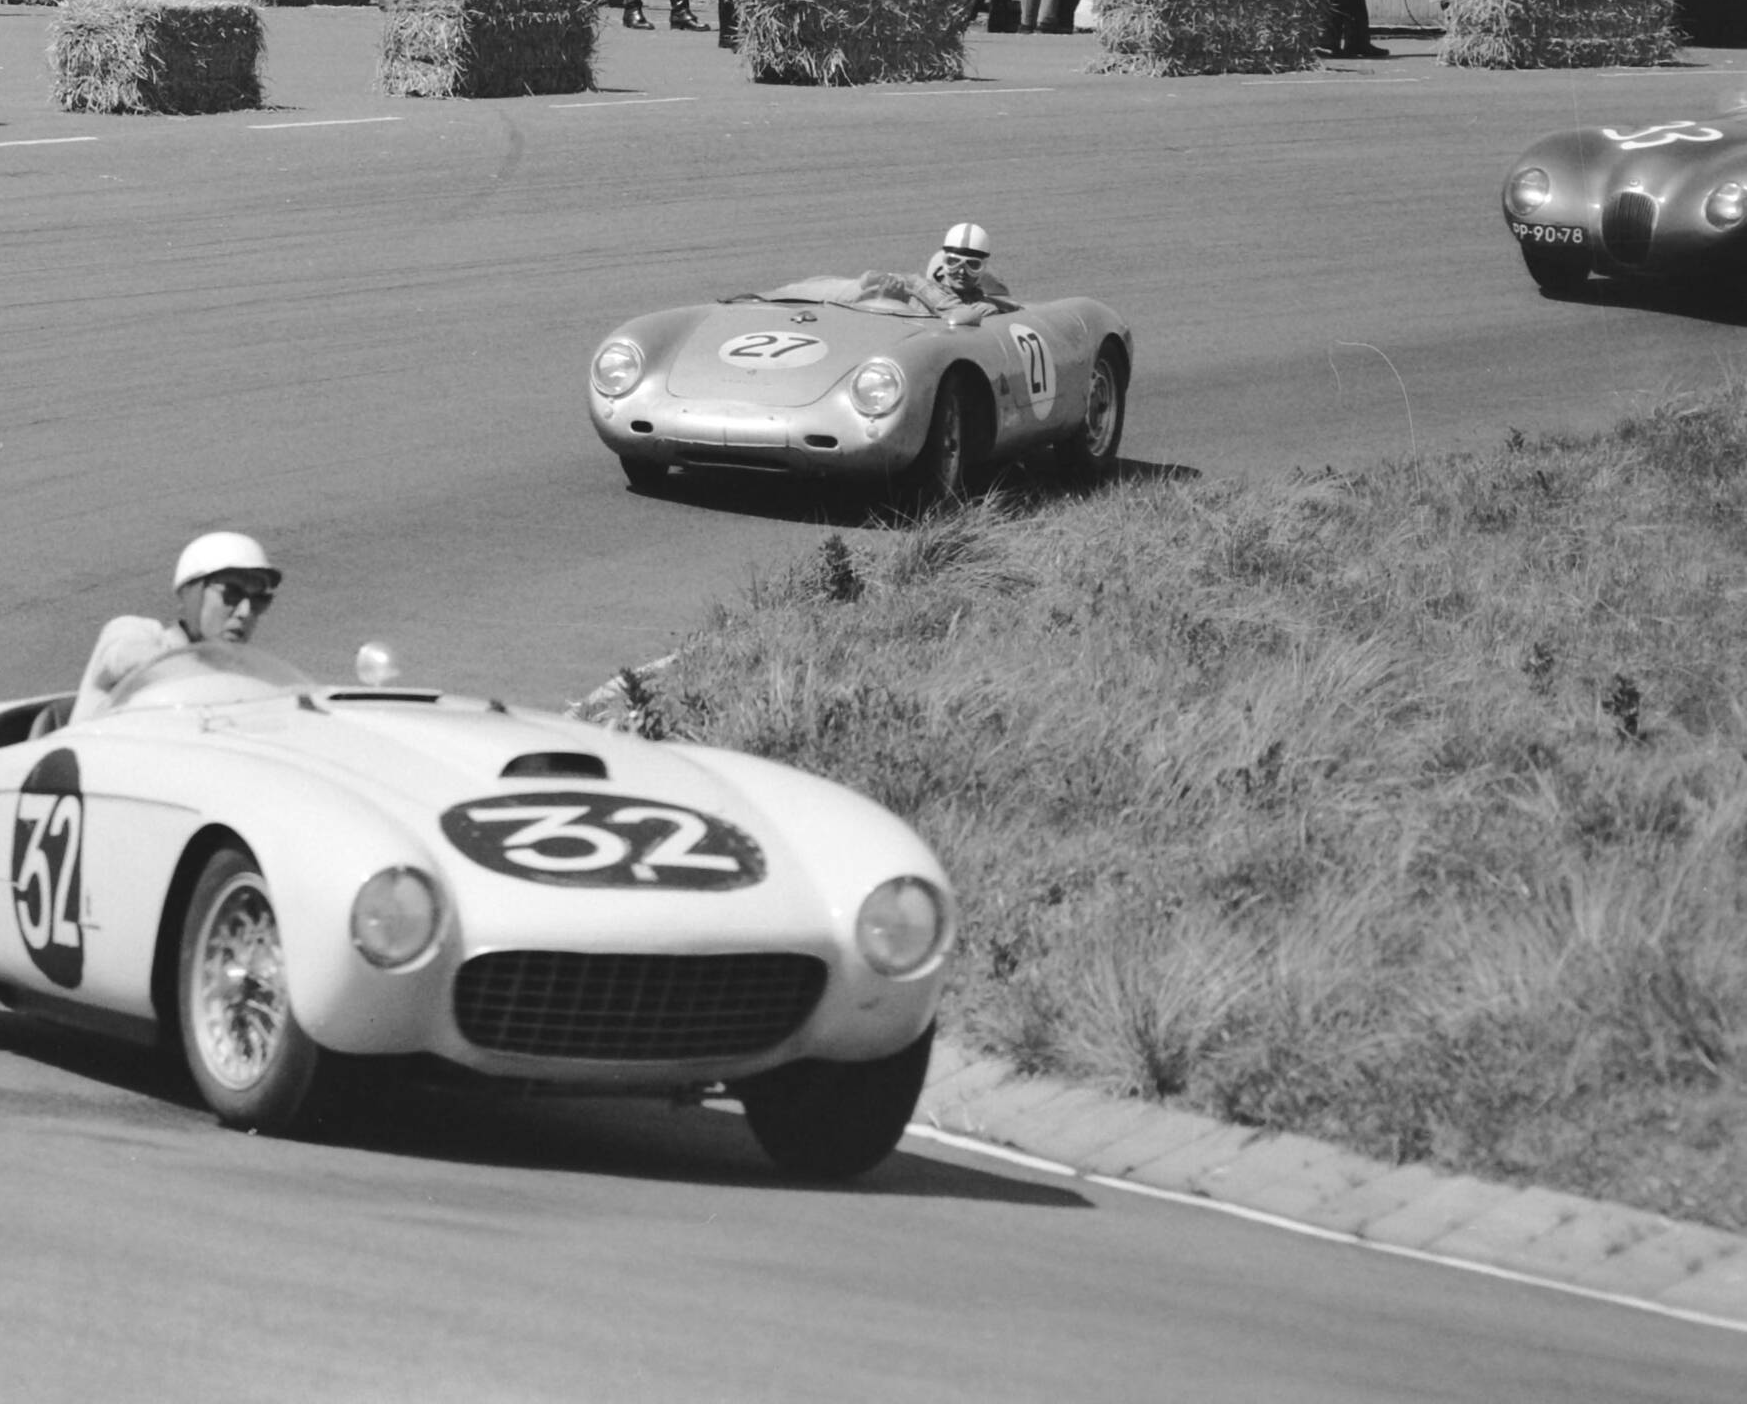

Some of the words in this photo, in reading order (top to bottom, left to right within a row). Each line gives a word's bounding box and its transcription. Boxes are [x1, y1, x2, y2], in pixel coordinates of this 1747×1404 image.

[1512, 222, 1584, 244] PP-90-78
[729, 334, 820, 358] 27
[1017, 332, 1047, 394] 27
[17, 793, 81, 950] 32
[466, 805, 741, 881] 32
